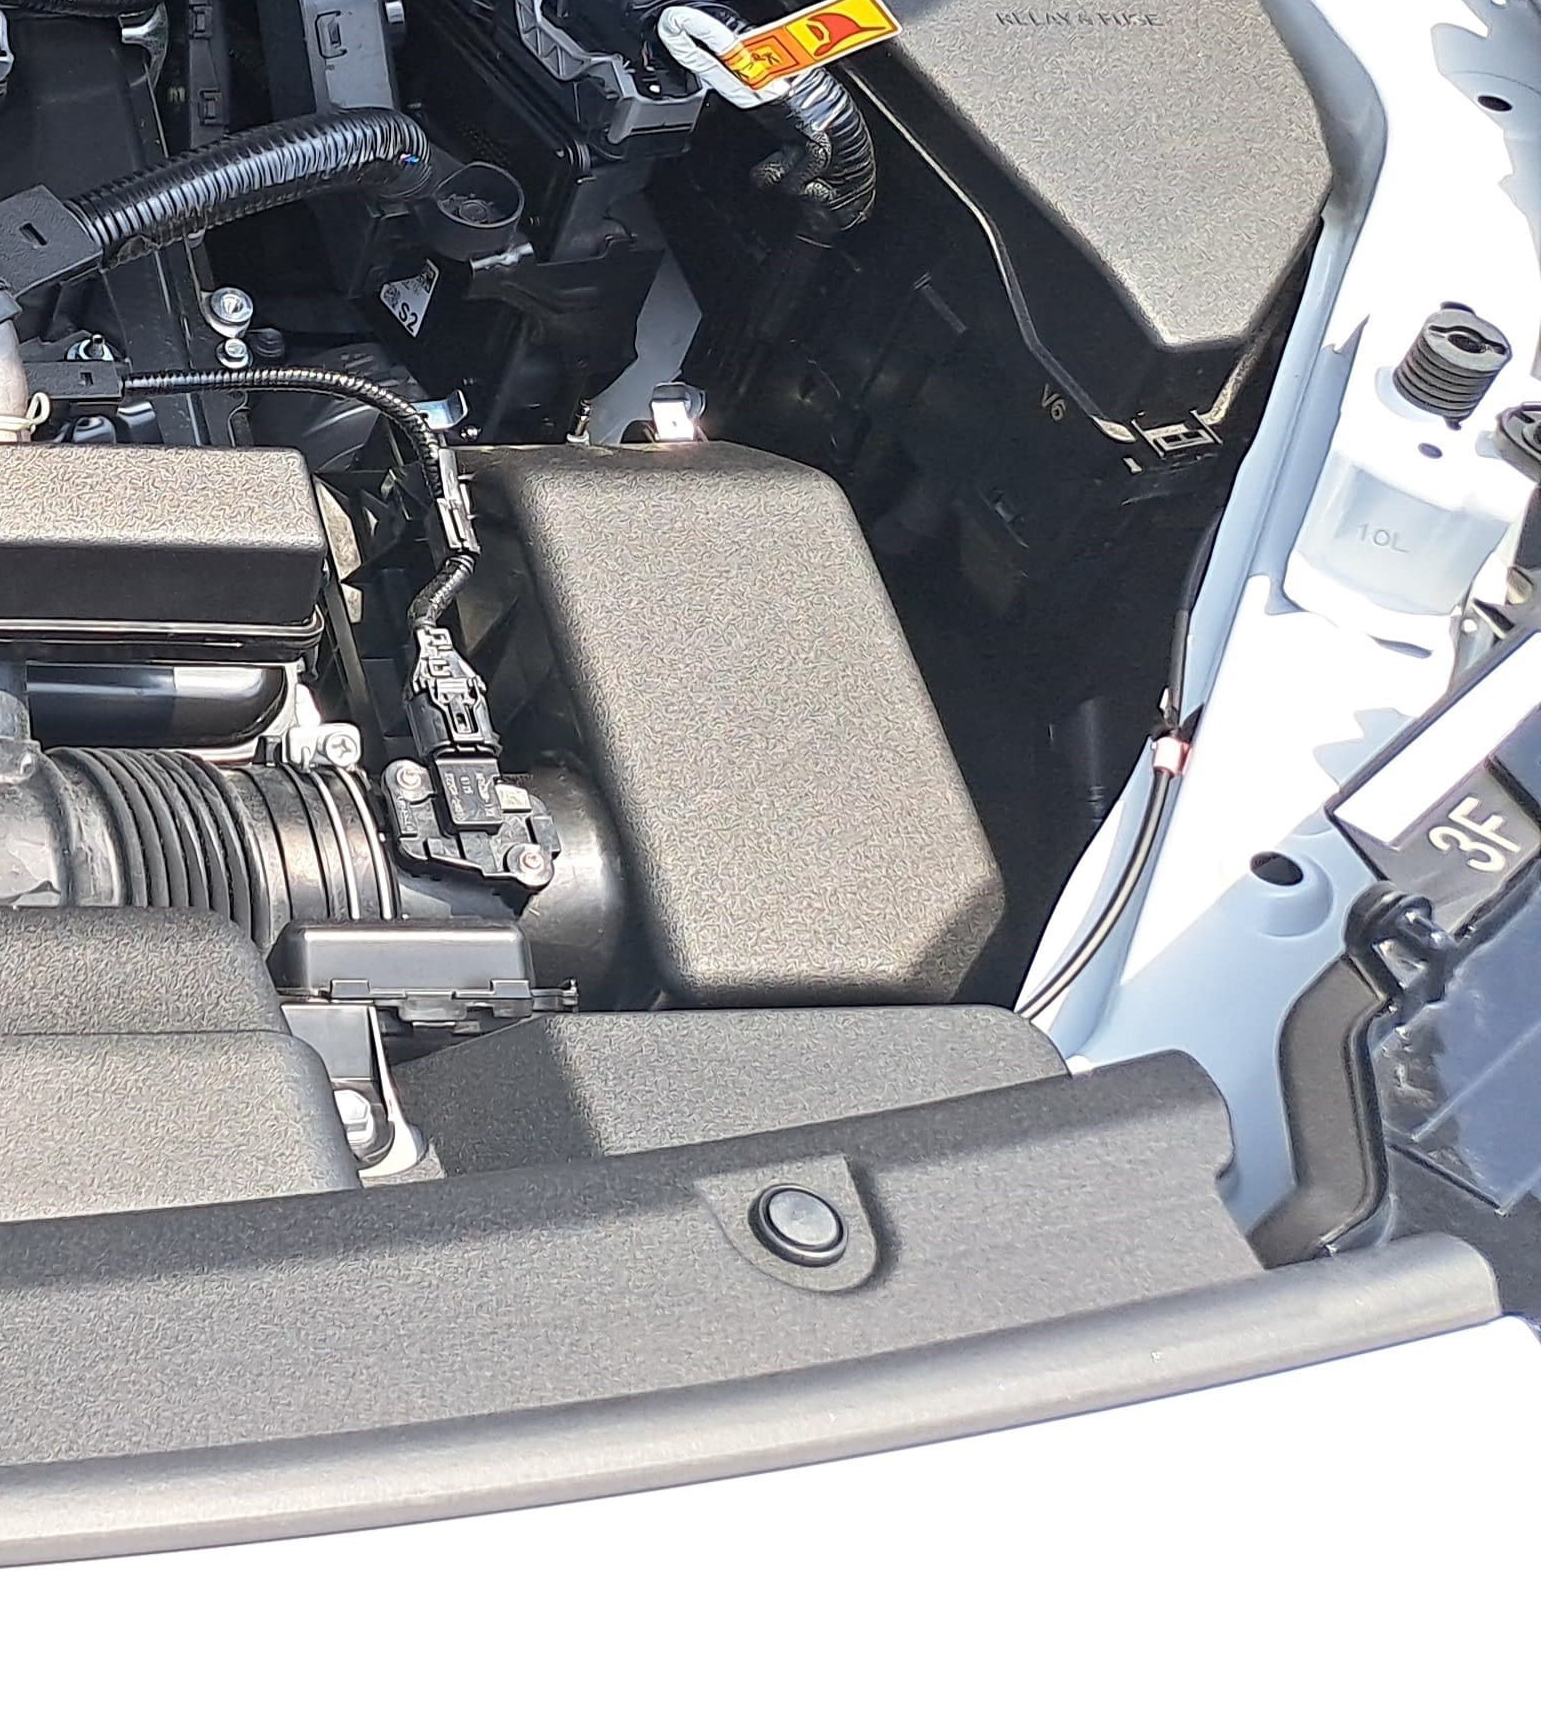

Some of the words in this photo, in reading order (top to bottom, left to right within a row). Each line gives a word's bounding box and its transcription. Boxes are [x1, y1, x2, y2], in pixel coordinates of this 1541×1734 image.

[995, 11, 1069, 27] RELAY
[398, 301, 419, 334] S2
[1041, 382, 1067, 422] V6
[1428, 795, 1522, 873] 3F
